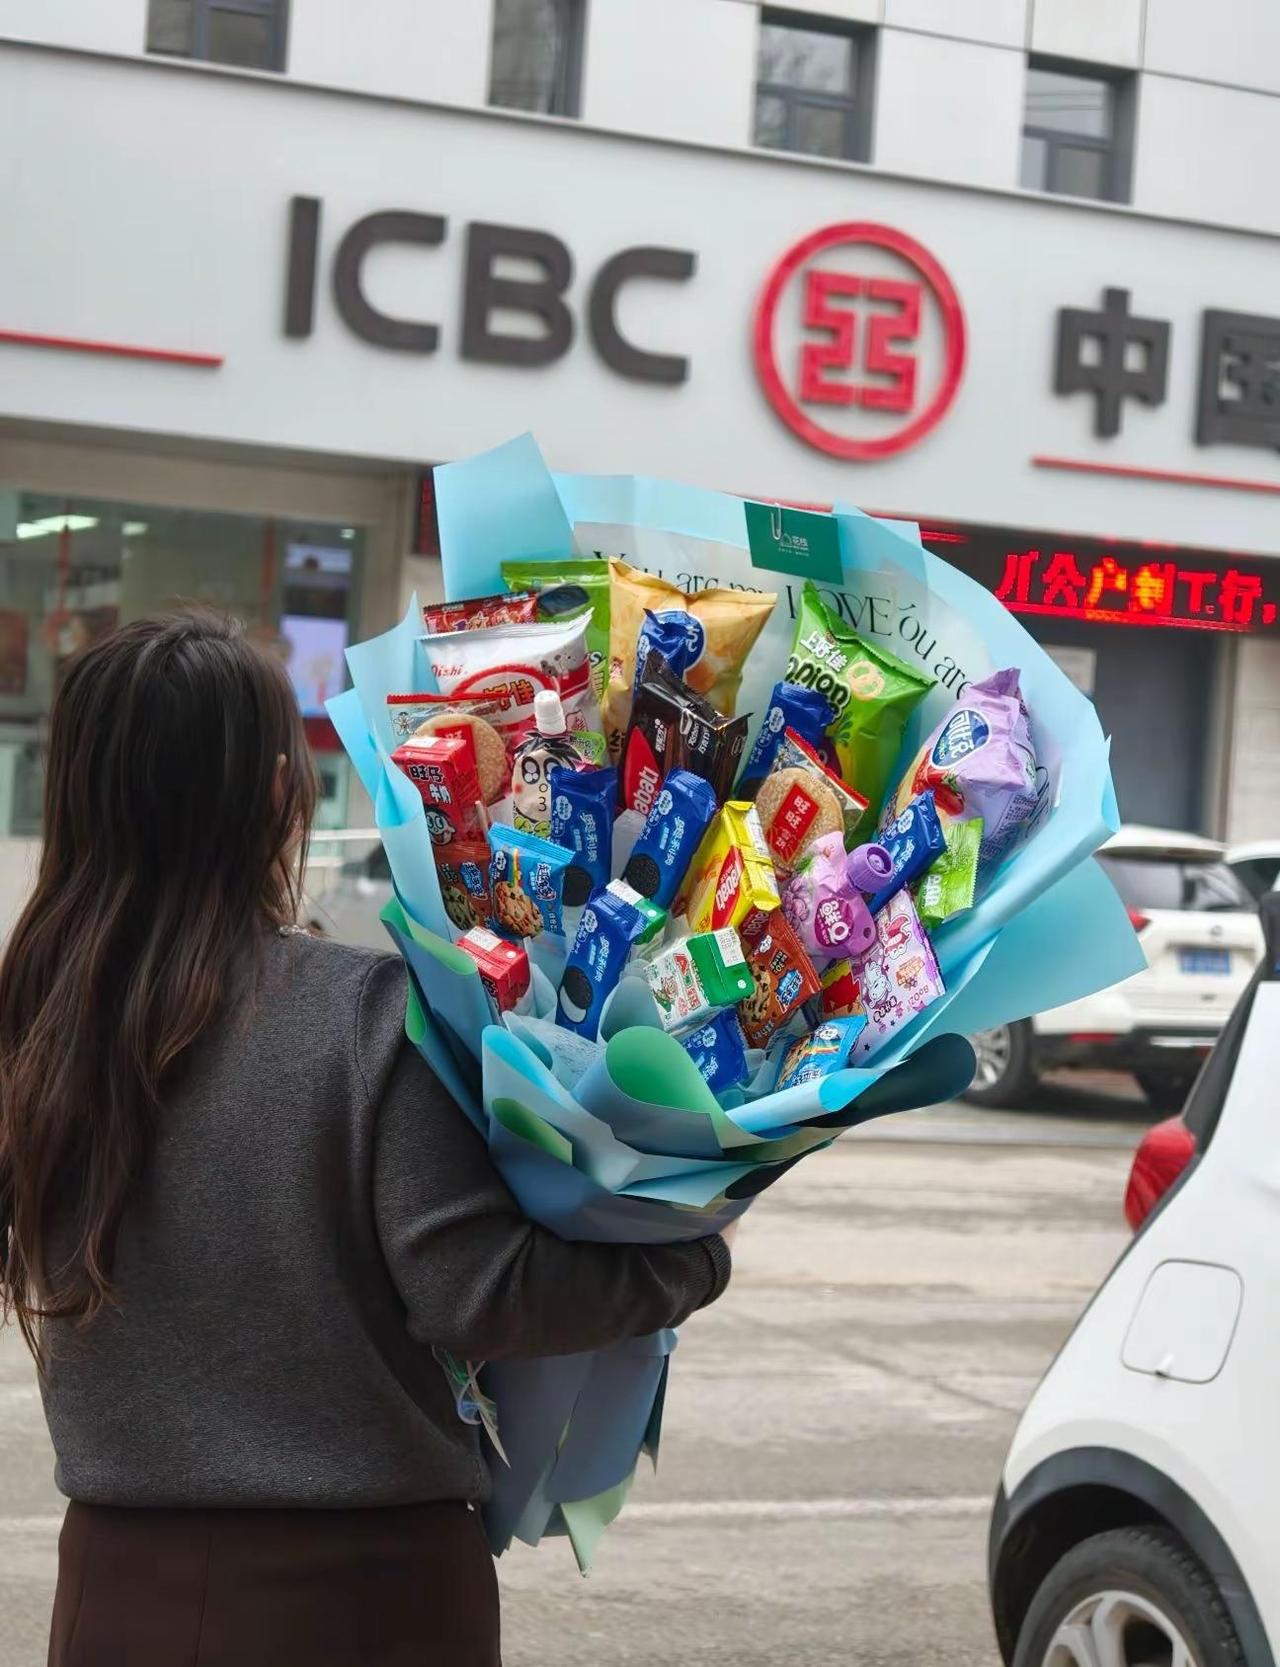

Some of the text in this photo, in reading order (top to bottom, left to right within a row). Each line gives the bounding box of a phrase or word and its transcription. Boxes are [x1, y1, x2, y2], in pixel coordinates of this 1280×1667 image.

[281, 194, 698, 386] ICBC
[799, 630, 849, 673] 上好佳
[633, 765, 660, 815] abati
